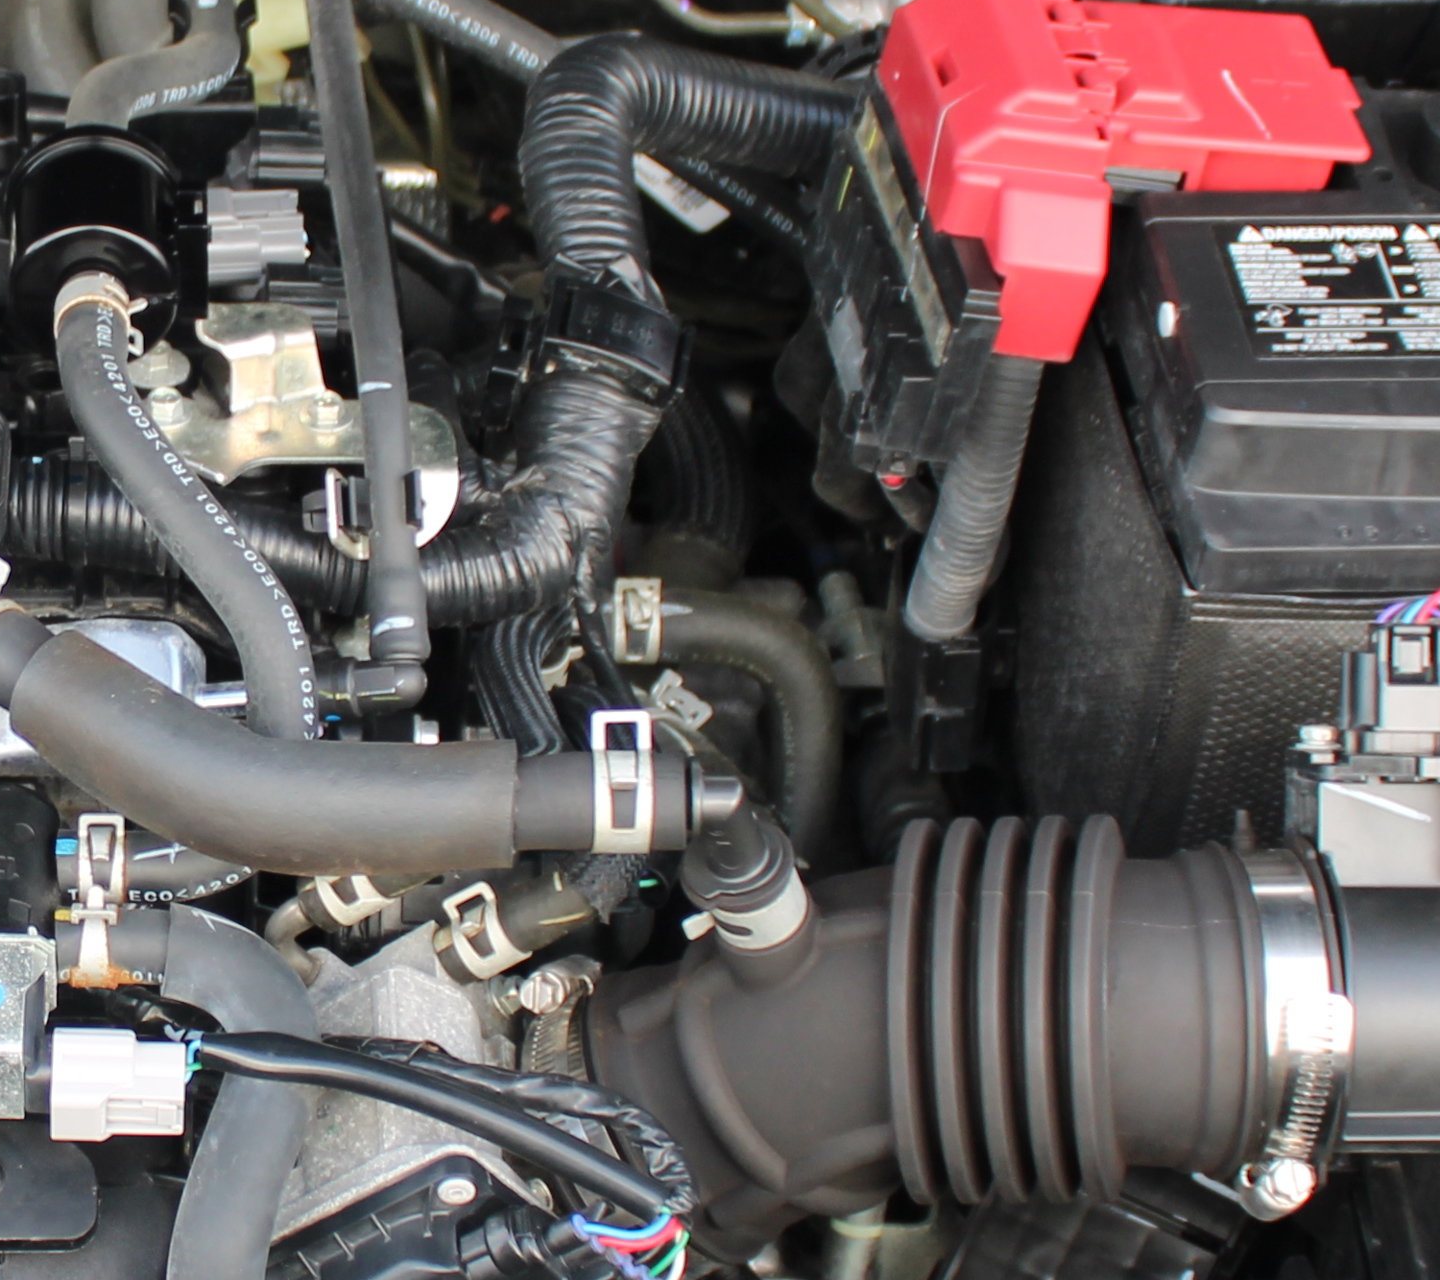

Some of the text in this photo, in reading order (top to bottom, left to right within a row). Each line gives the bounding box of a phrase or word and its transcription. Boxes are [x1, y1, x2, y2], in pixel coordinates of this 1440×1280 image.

[1263, 226, 1399, 240] DANGER/POISON
[101, 354, 194, 486] TRD>ECO<4201
[196, 492, 305, 650] TRD>ECO<4201
